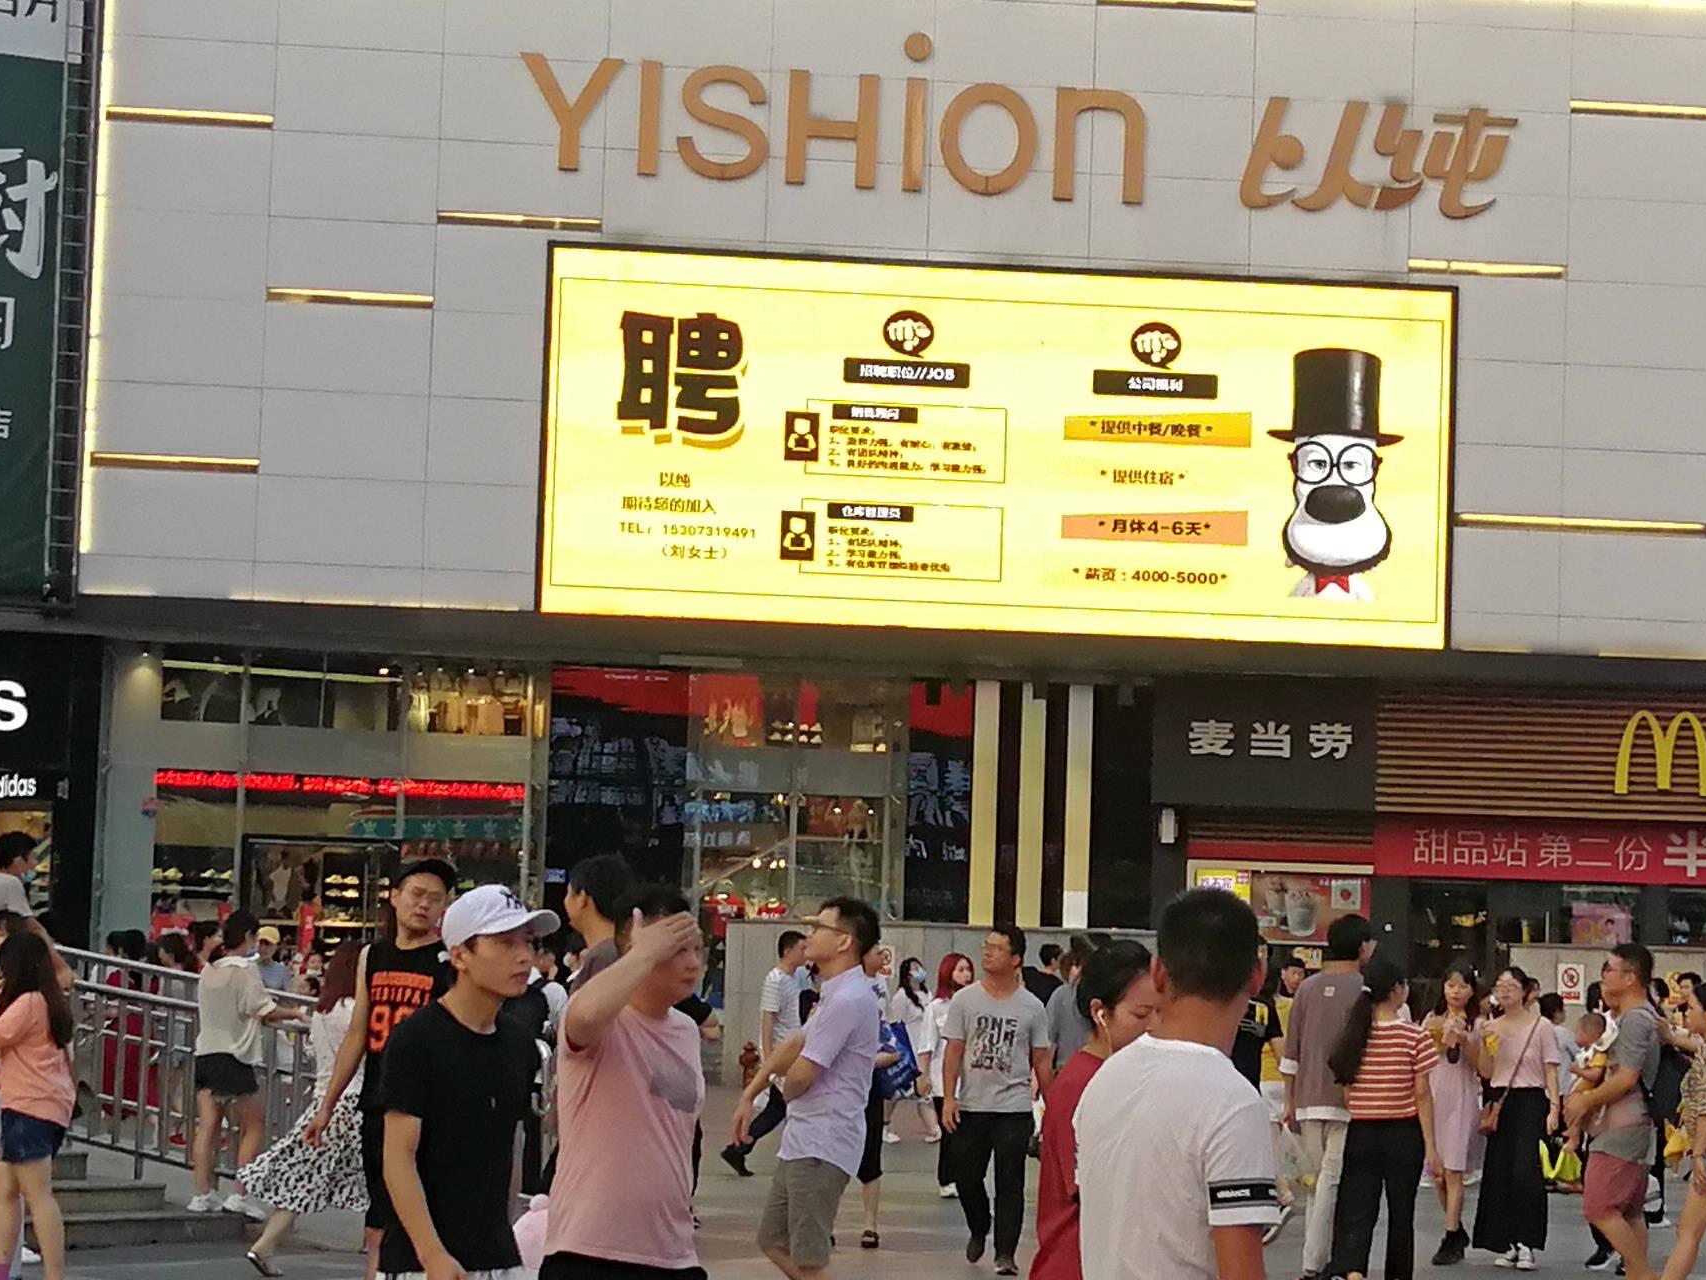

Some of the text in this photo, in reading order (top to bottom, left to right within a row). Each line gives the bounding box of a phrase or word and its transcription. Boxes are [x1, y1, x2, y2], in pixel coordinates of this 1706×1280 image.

[617, 310, 747, 436] 聘
[659, 472, 691, 488] 以纯
[1188, 719, 1354, 761] 麦当劳
